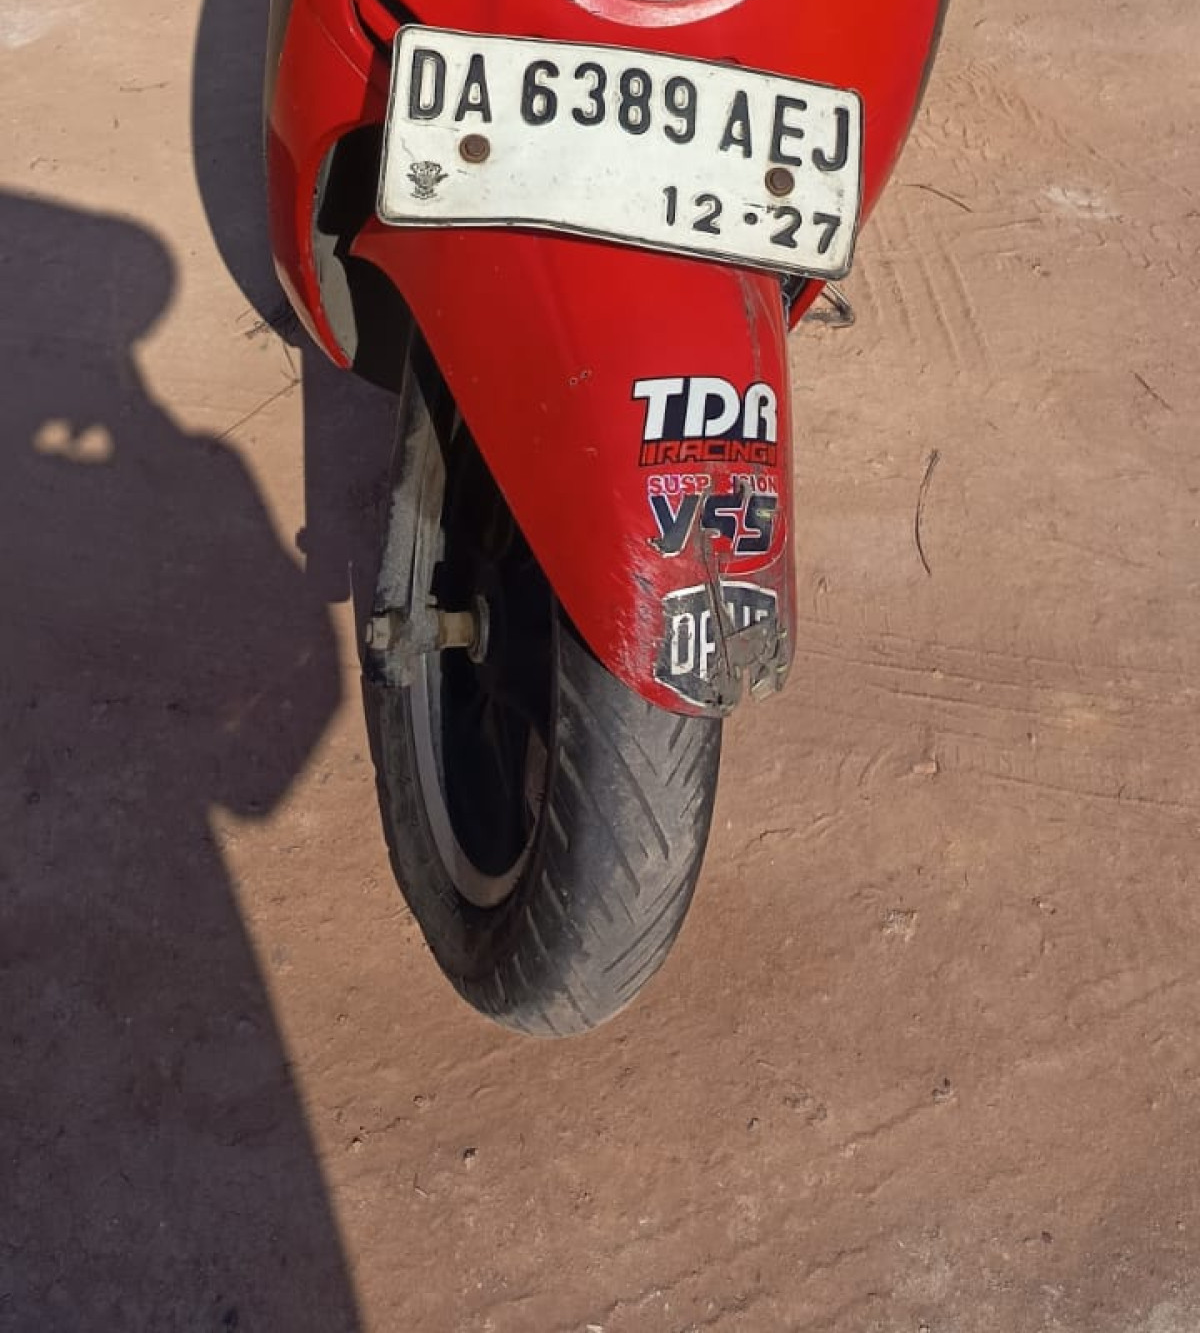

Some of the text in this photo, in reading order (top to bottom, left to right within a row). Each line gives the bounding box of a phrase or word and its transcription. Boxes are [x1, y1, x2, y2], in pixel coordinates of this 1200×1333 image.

[408, 48, 851, 173] DA 6389 AEJ
[633, 377, 778, 443] TDR
[656, 440, 769, 464] RACING
